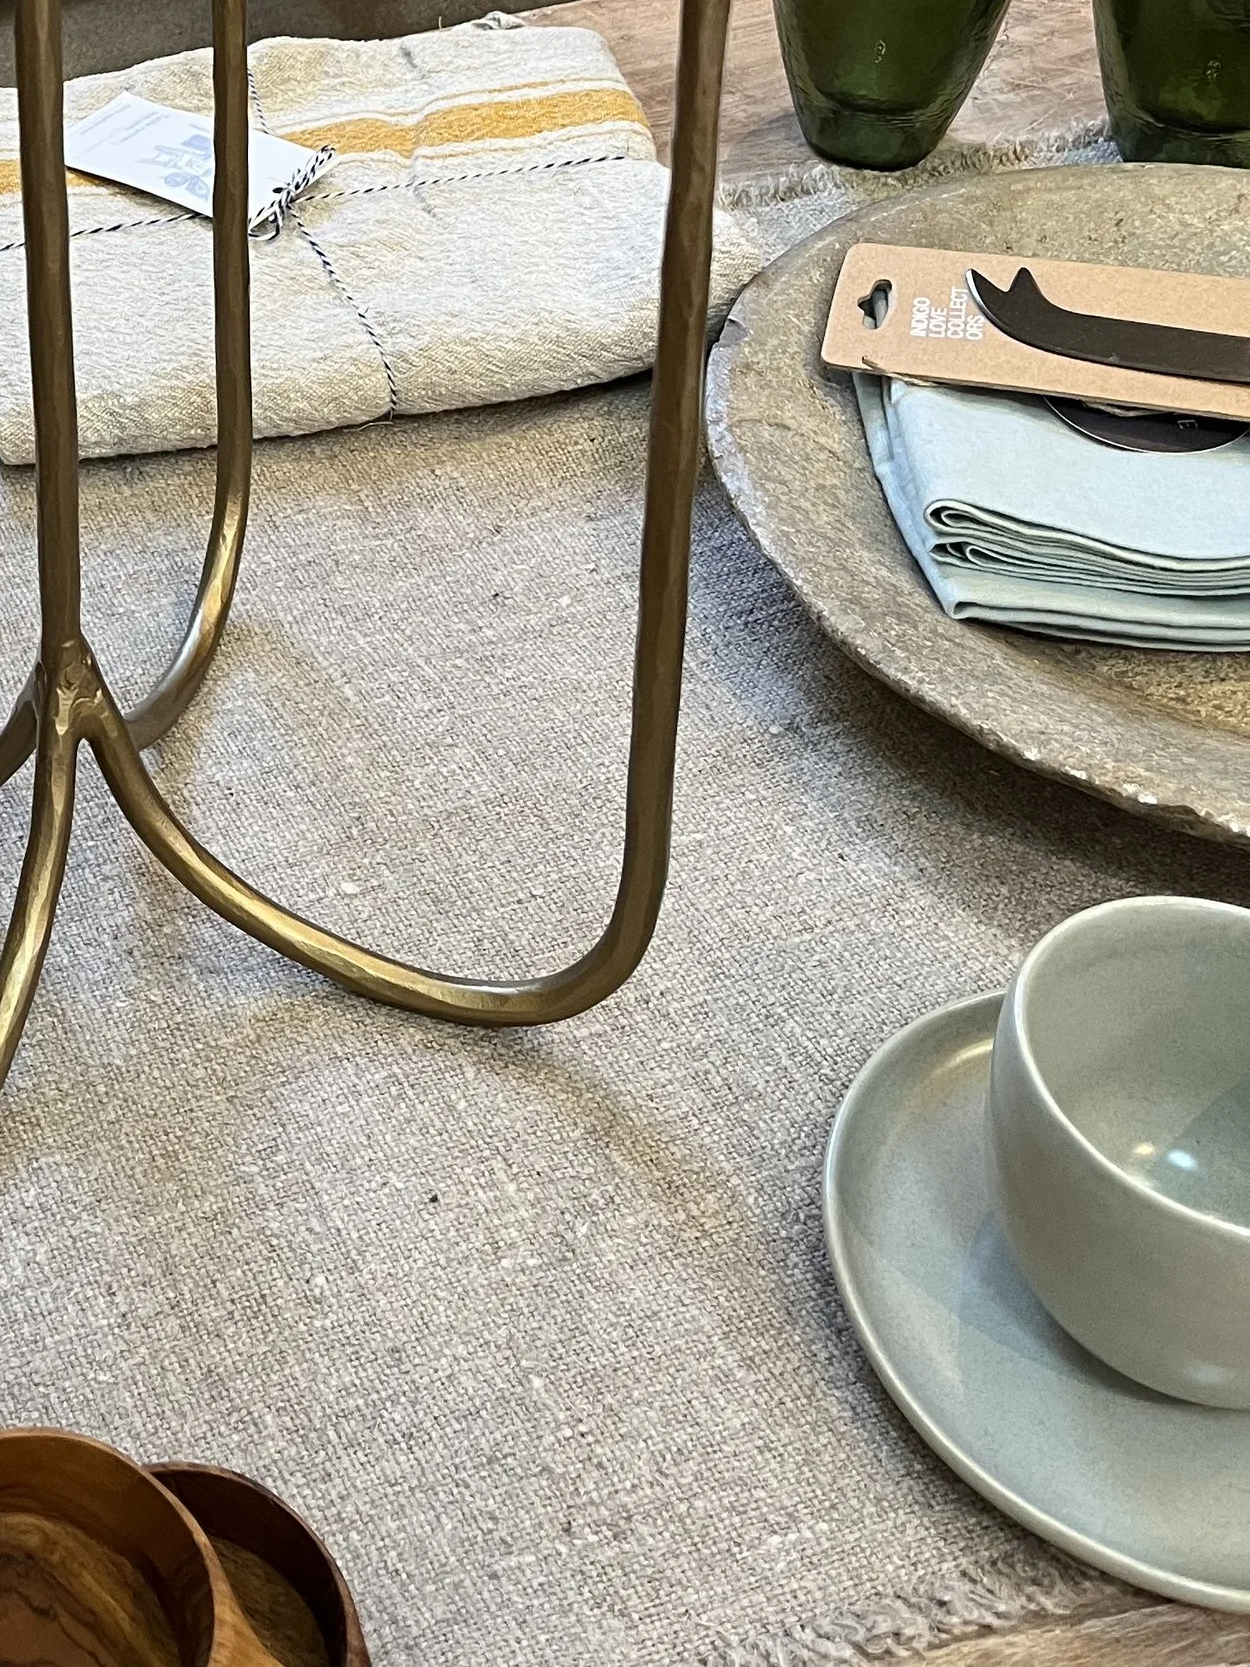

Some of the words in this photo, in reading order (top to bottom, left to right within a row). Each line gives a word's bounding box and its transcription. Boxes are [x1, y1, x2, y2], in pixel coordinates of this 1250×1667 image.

[910, 297, 931, 337] INDIGO
[929, 307, 947, 338] LOVE
[947, 285, 968, 339] COLLECT
[965, 315, 985, 341] ORS
